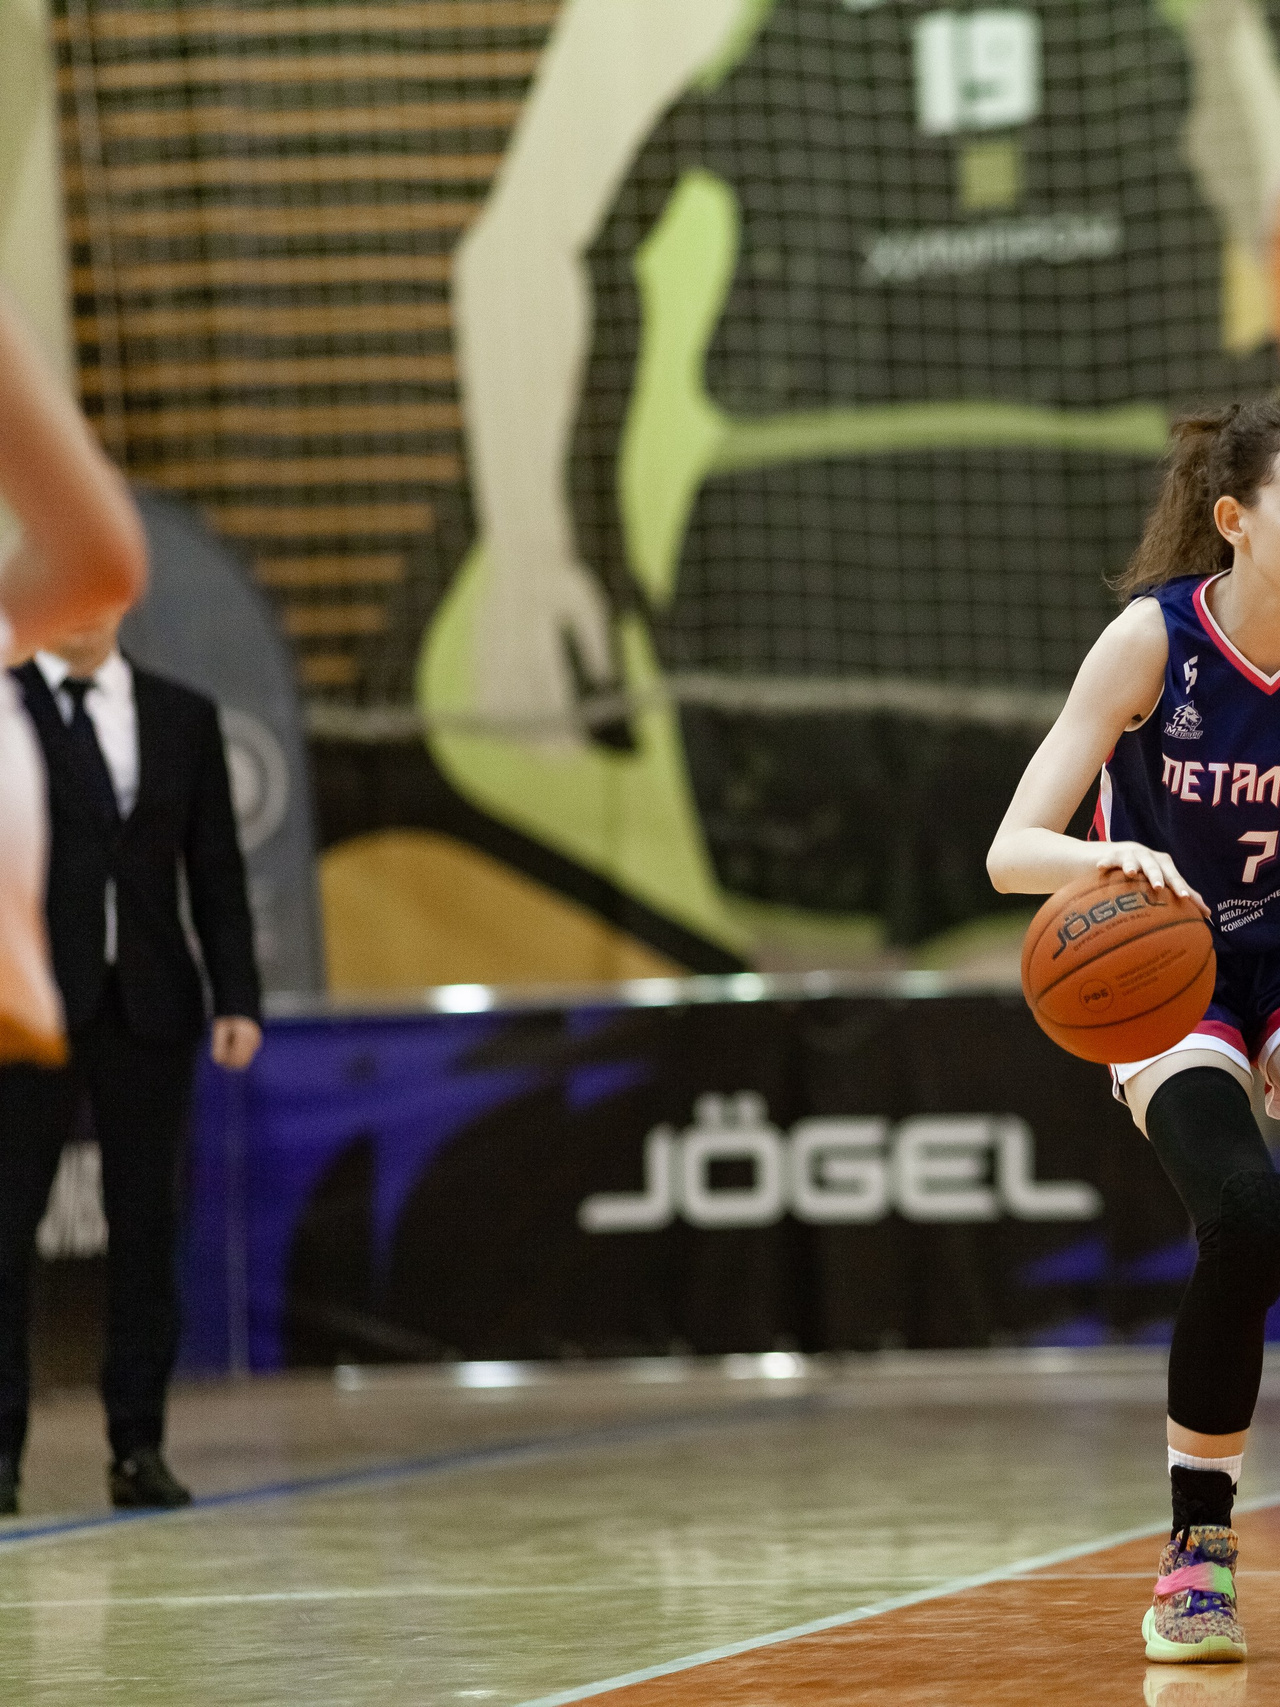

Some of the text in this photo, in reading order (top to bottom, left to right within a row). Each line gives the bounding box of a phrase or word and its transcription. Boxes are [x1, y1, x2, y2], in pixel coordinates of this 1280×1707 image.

[913, 11, 1042, 136] 19
[1237, 830, 1279, 884] 7
[1052, 891, 1168, 960] JÖGEL
[1220, 907, 1264, 932] КОМБИНАТ
[579, 1092, 1100, 1232] JÖGEL
